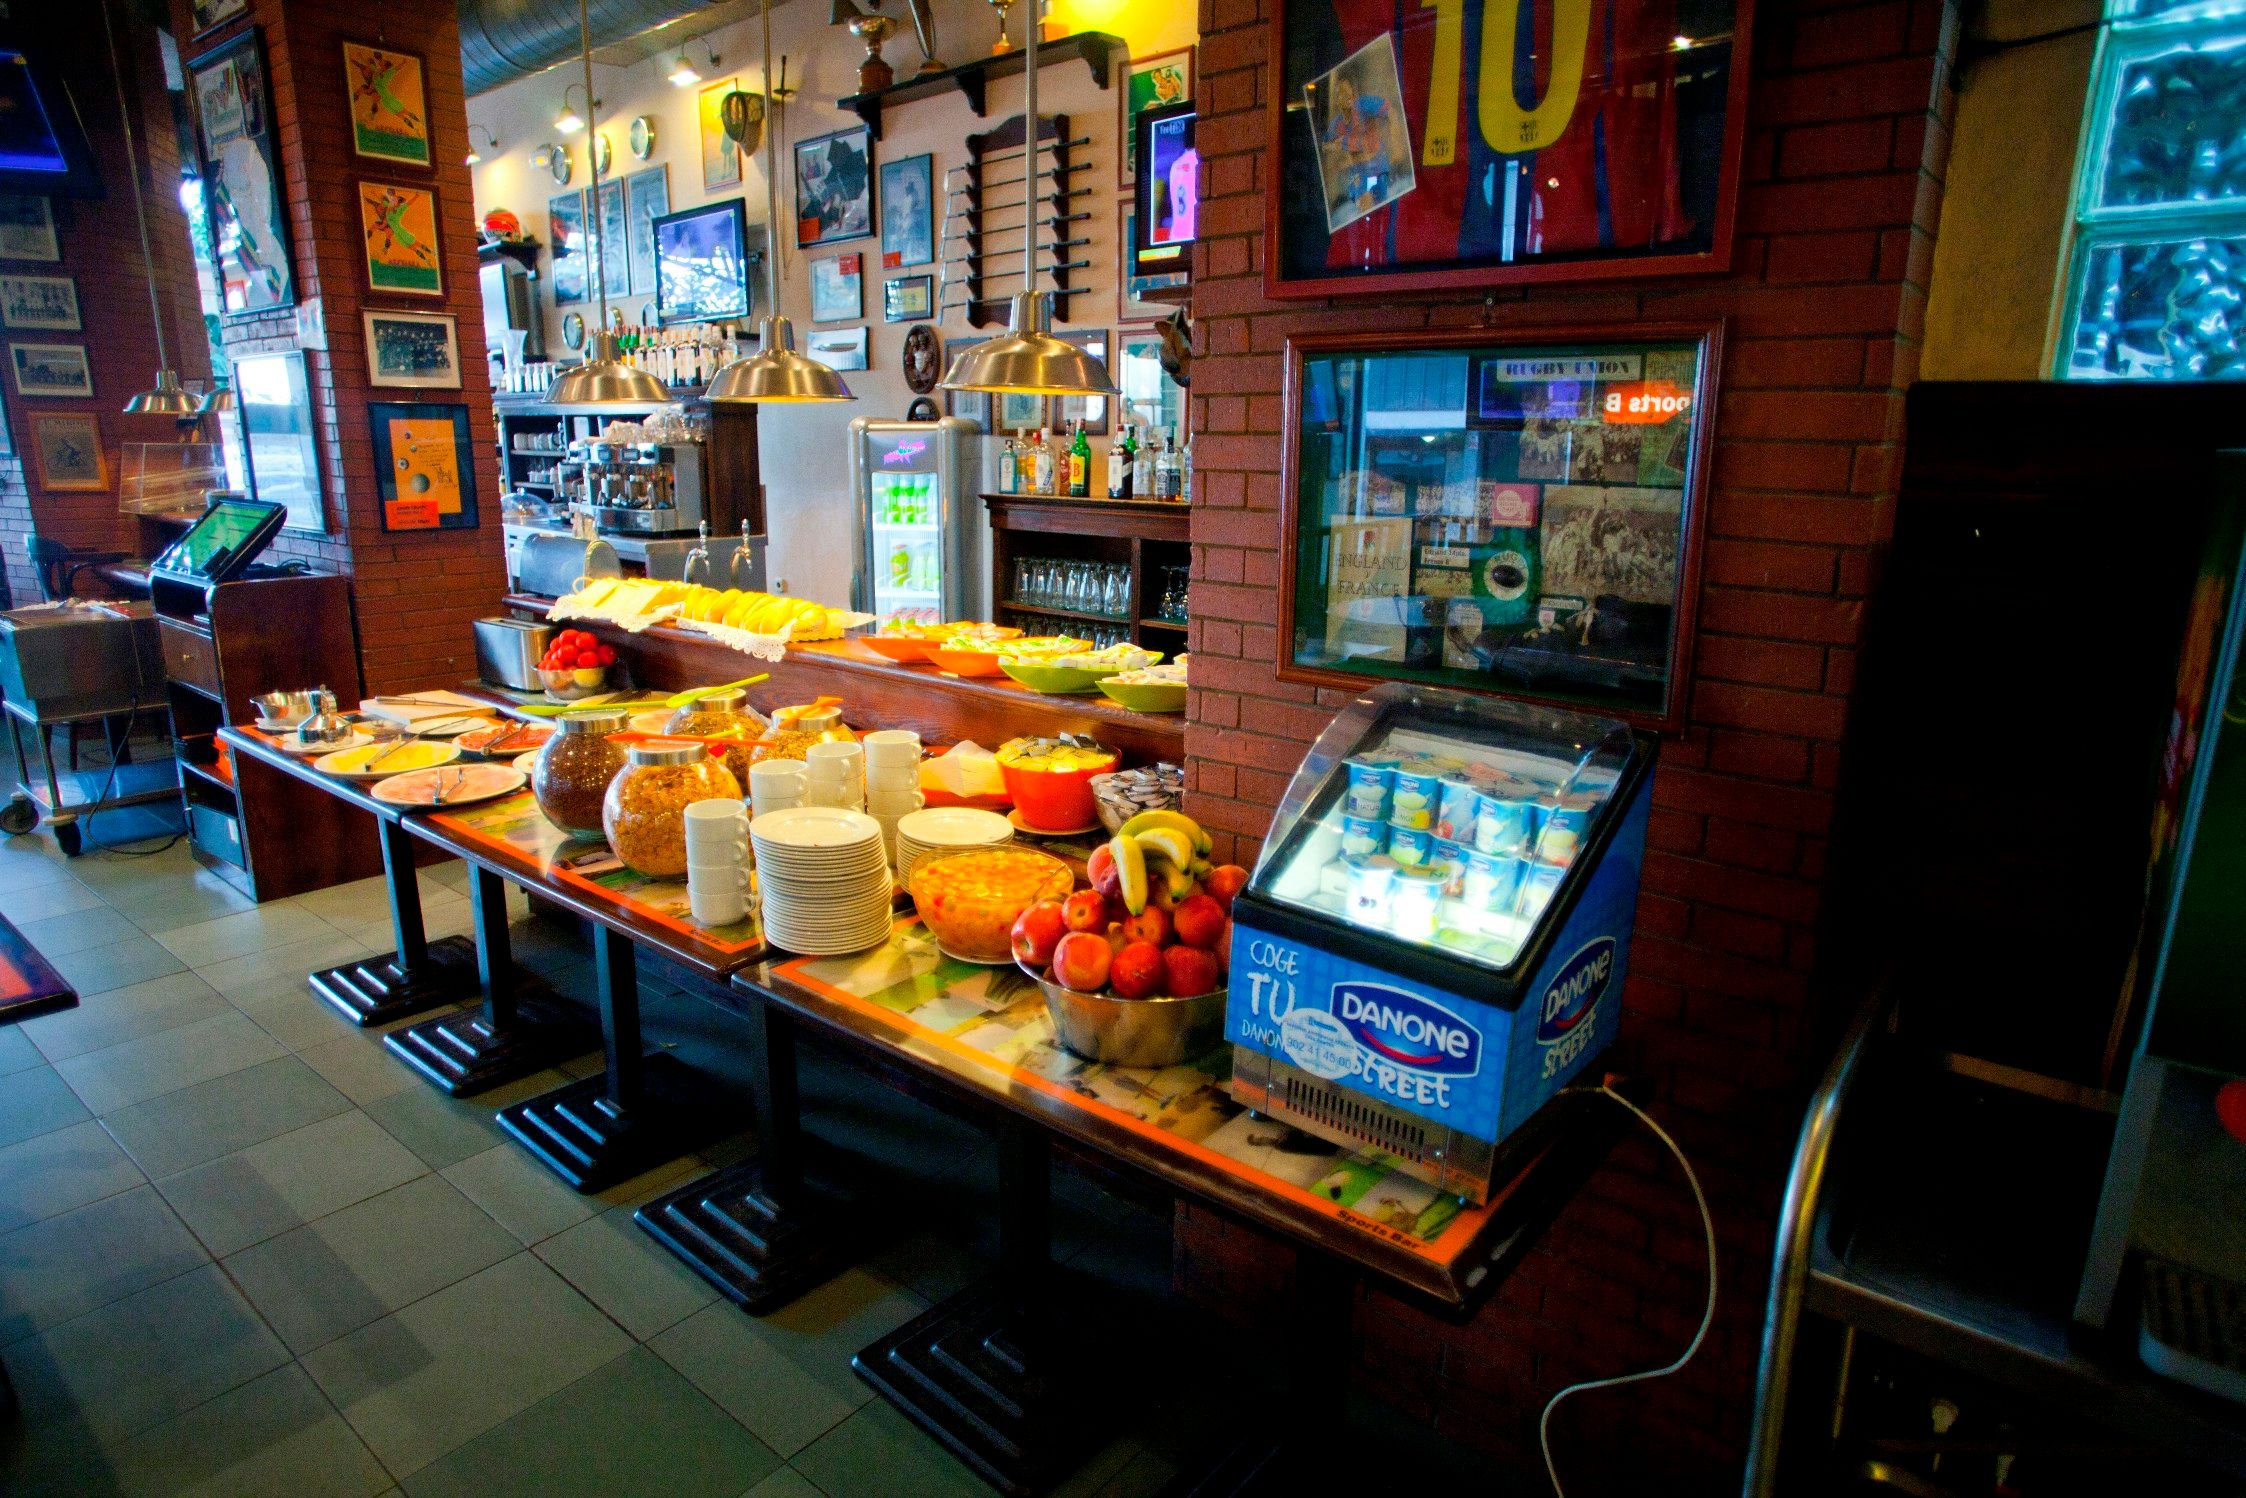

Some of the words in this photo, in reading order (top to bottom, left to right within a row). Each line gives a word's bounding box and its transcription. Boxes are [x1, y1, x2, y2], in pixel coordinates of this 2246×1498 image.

[1421, 0, 1592, 166] 10
[1506, 361, 1565, 376] RUGBY
[1574, 361, 1630, 375] UNION
[1338, 554, 1407, 570] ENGLAND
[1337, 580, 1400, 597] FRANCE
[1250, 940, 1299, 975] COGE
[1247, 972, 1296, 1027] TU
[1241, 1019, 1285, 1051] DANON
[1337, 1210, 1387, 1236] Sports
[1391, 1231, 1420, 1248] Bar
